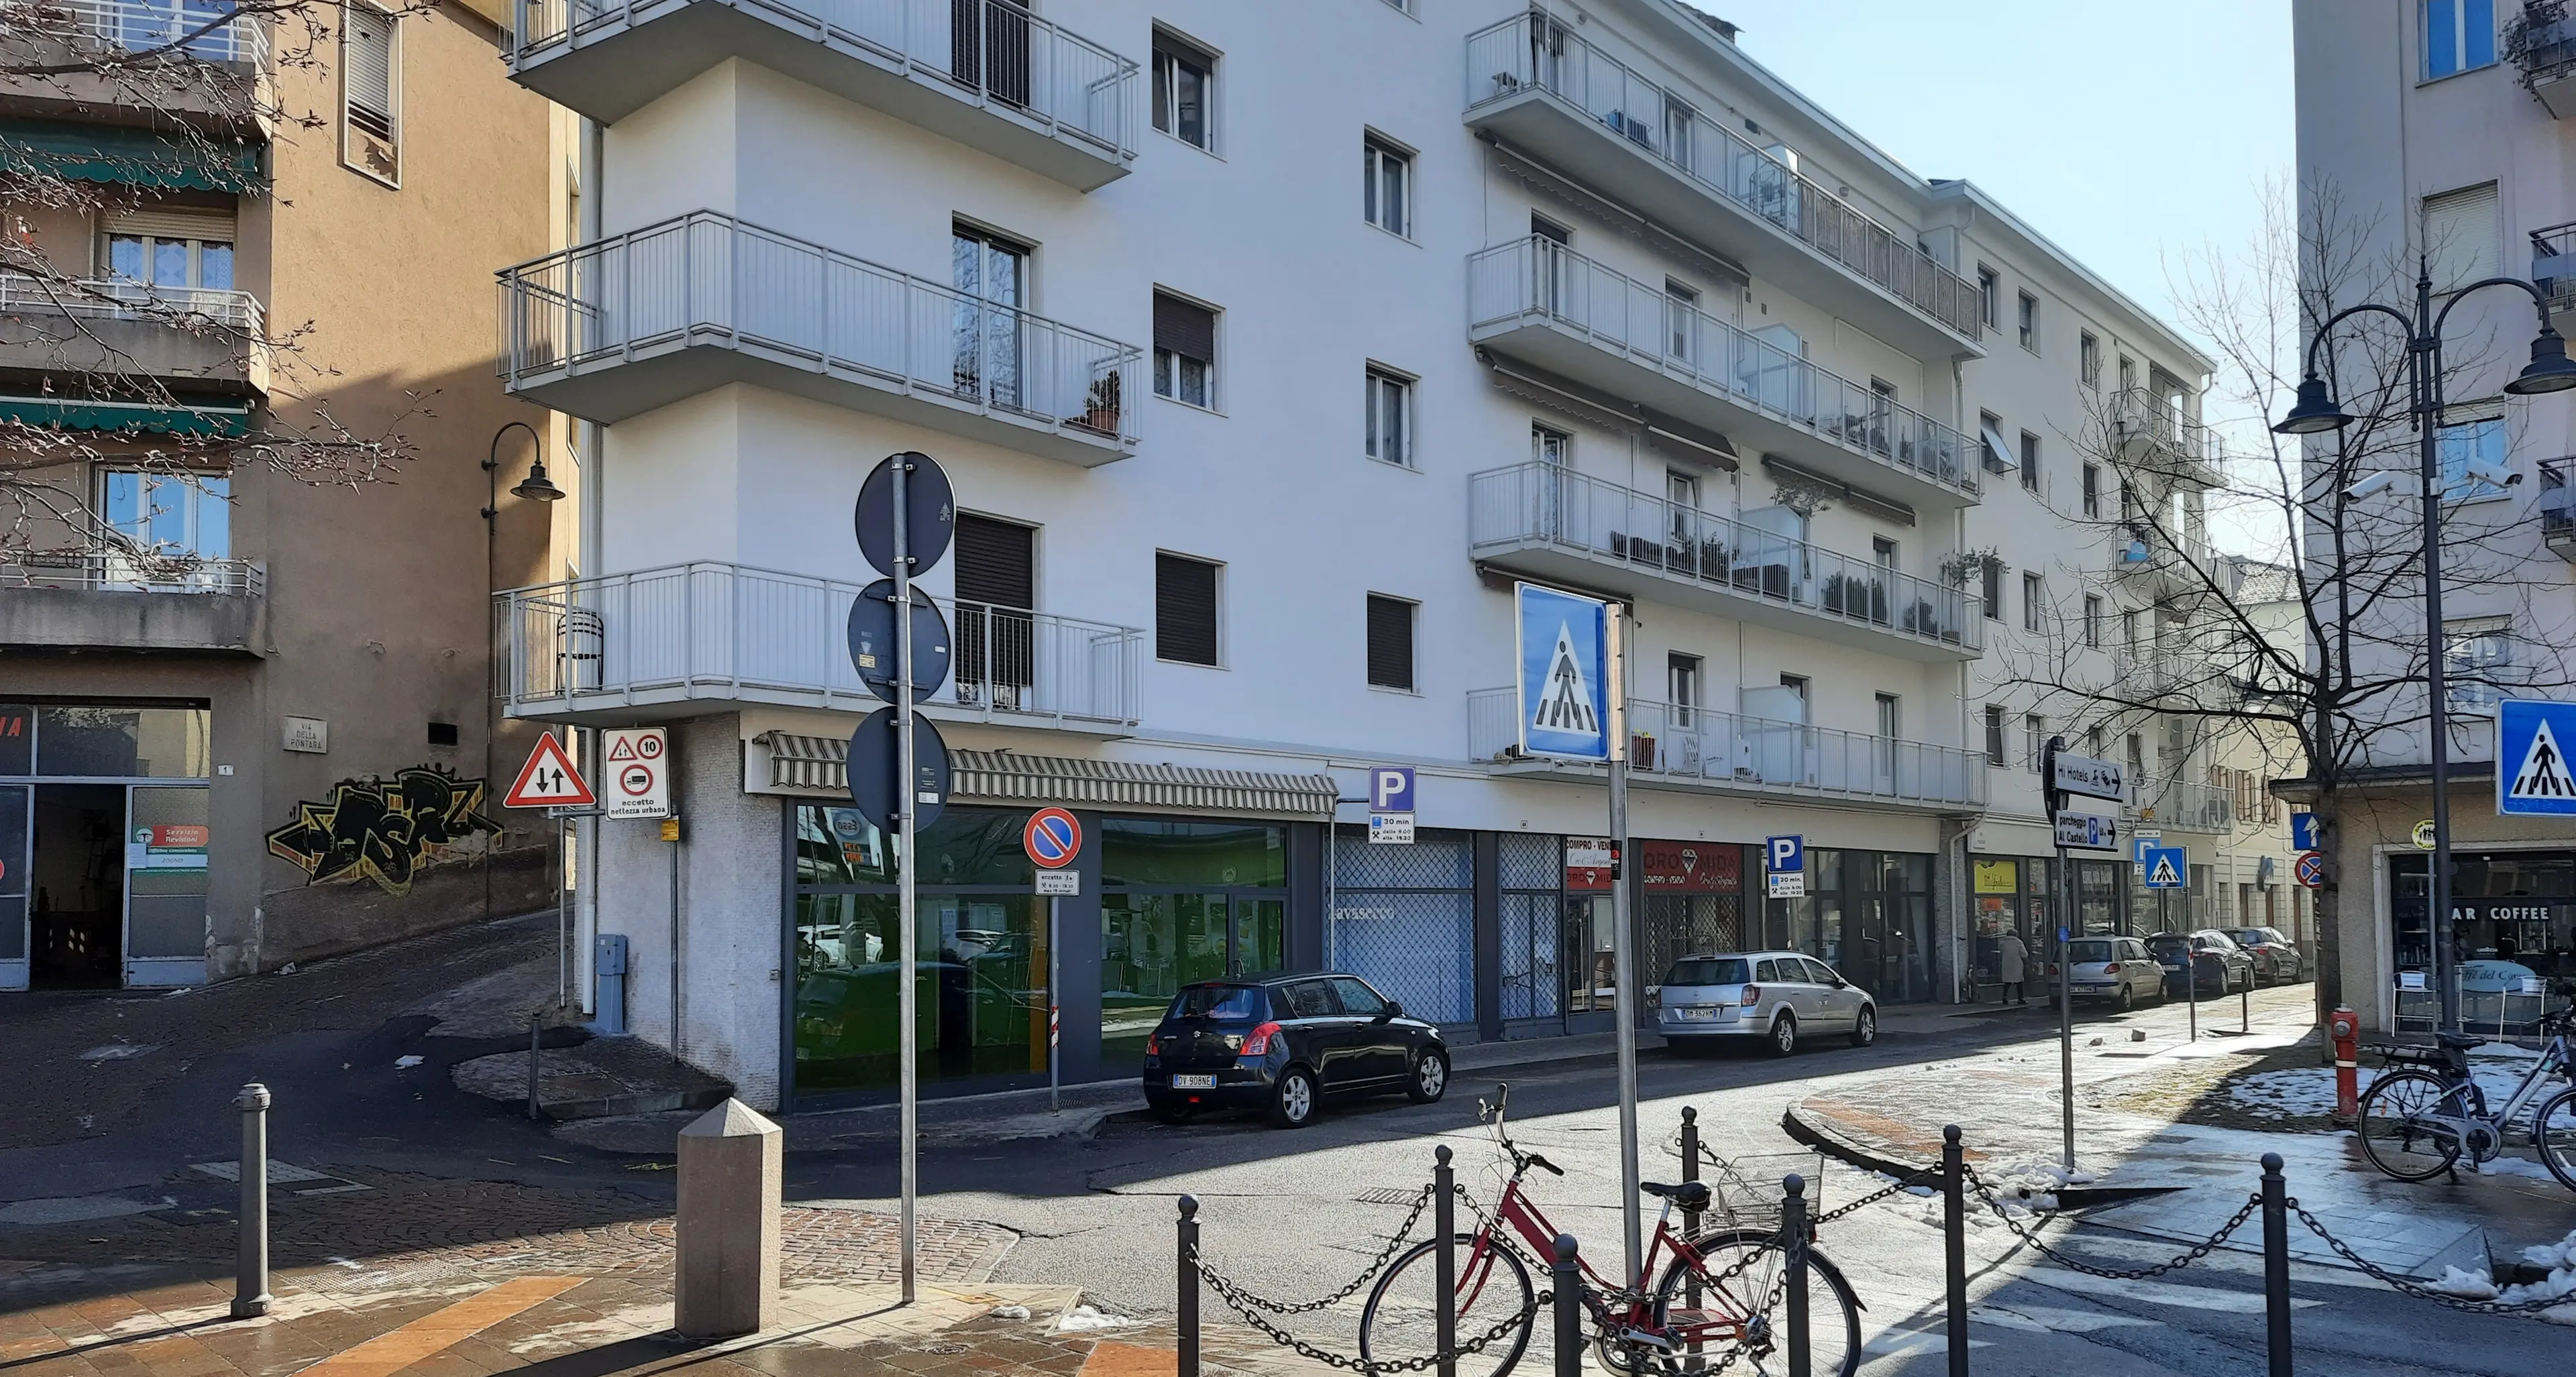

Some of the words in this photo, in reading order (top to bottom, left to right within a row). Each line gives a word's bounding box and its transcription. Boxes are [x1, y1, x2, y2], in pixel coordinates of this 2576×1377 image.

[297, 730, 316, 740] DELLA
[290, 738, 321, 749] PONTARA
[644, 741, 656, 753] 10
[2058, 763, 2065, 778] Hi
[2067, 766, 2089, 783] Hotels
[1379, 771, 1406, 807] P
[2059, 816, 2086, 830] parcheggio
[2058, 831, 2065, 841] Al
[2067, 832, 2088, 844] Castello
[2091, 820, 2097, 842] P
[1566, 840, 1592, 850] COMPRO
[1597, 841, 1611, 850] VEN
[1774, 839, 1796, 869] P
[1644, 852, 1679, 869] ORO
[1597, 874, 1612, 882] MID
[2452, 907, 2476, 920] AR
[2490, 907, 2549, 920] COFFEE
[2480, 970, 2496, 979] del
[1179, 1076, 1187, 1085] DV
[1189, 1076, 1211, 1085] 908NE
